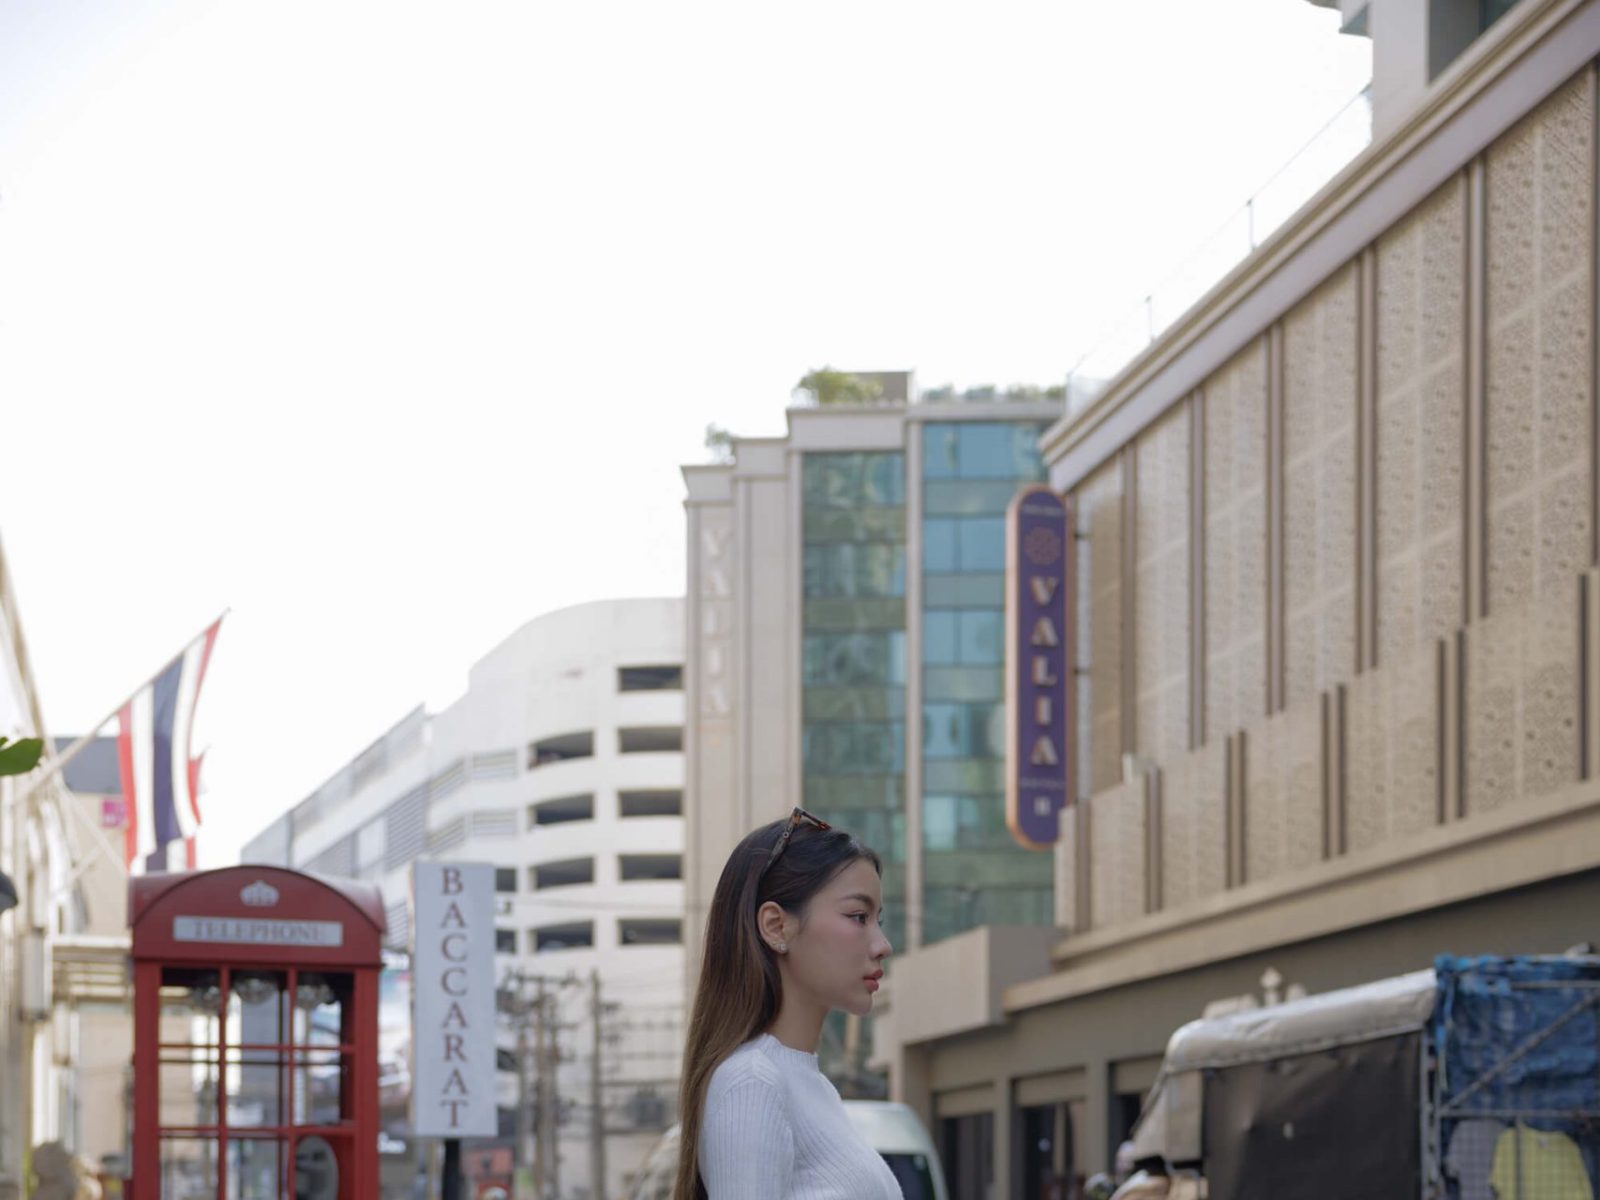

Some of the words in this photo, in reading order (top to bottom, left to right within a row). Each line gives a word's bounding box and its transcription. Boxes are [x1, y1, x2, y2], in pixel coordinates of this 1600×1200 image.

[1029, 575, 1060, 767] VALIA
[192, 919, 323, 942] TELEPHONE
[439, 866, 469, 1129] BACCARAT
